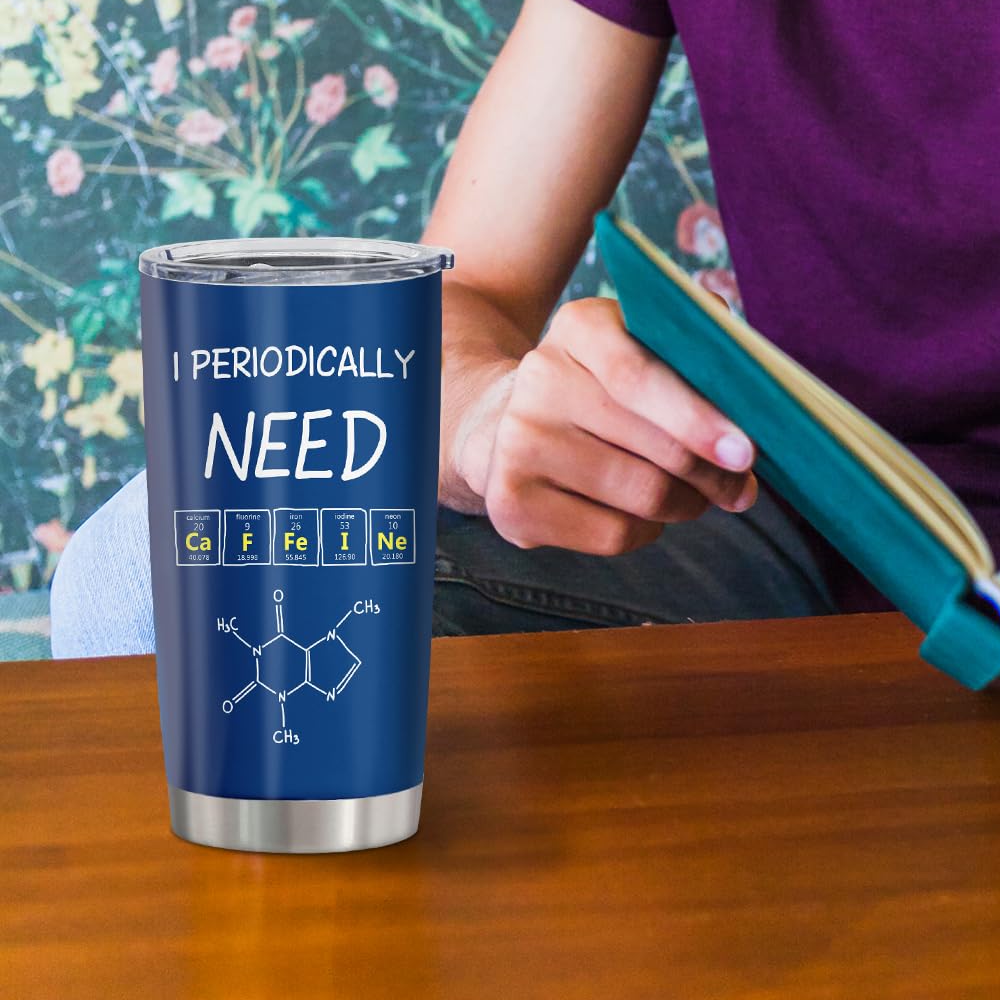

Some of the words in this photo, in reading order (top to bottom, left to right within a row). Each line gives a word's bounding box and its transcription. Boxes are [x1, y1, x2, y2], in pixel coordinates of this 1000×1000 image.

[173, 351, 179, 382] I
[191, 345, 416, 381] PERIODICALLY
[204, 408, 387, 482] NEED
[236, 513, 261, 521] fluorine
[193, 522, 205, 531] 20
[244, 522, 251, 531] 9
[290, 522, 302, 531] 26
[339, 521, 350, 530] 53
[388, 521, 399, 530] 10
[185, 532, 212, 551] Ca
[242, 532, 254, 552] F
[284, 532, 308, 551] Fe
[340, 532, 349, 550] I
[377, 532, 408, 550] Ne
[334, 553, 356, 561] 126.90
[326, 629, 336, 641] N
[252, 645, 262, 656] N
[278, 690, 286, 702] N
[326, 688, 336, 701] N
